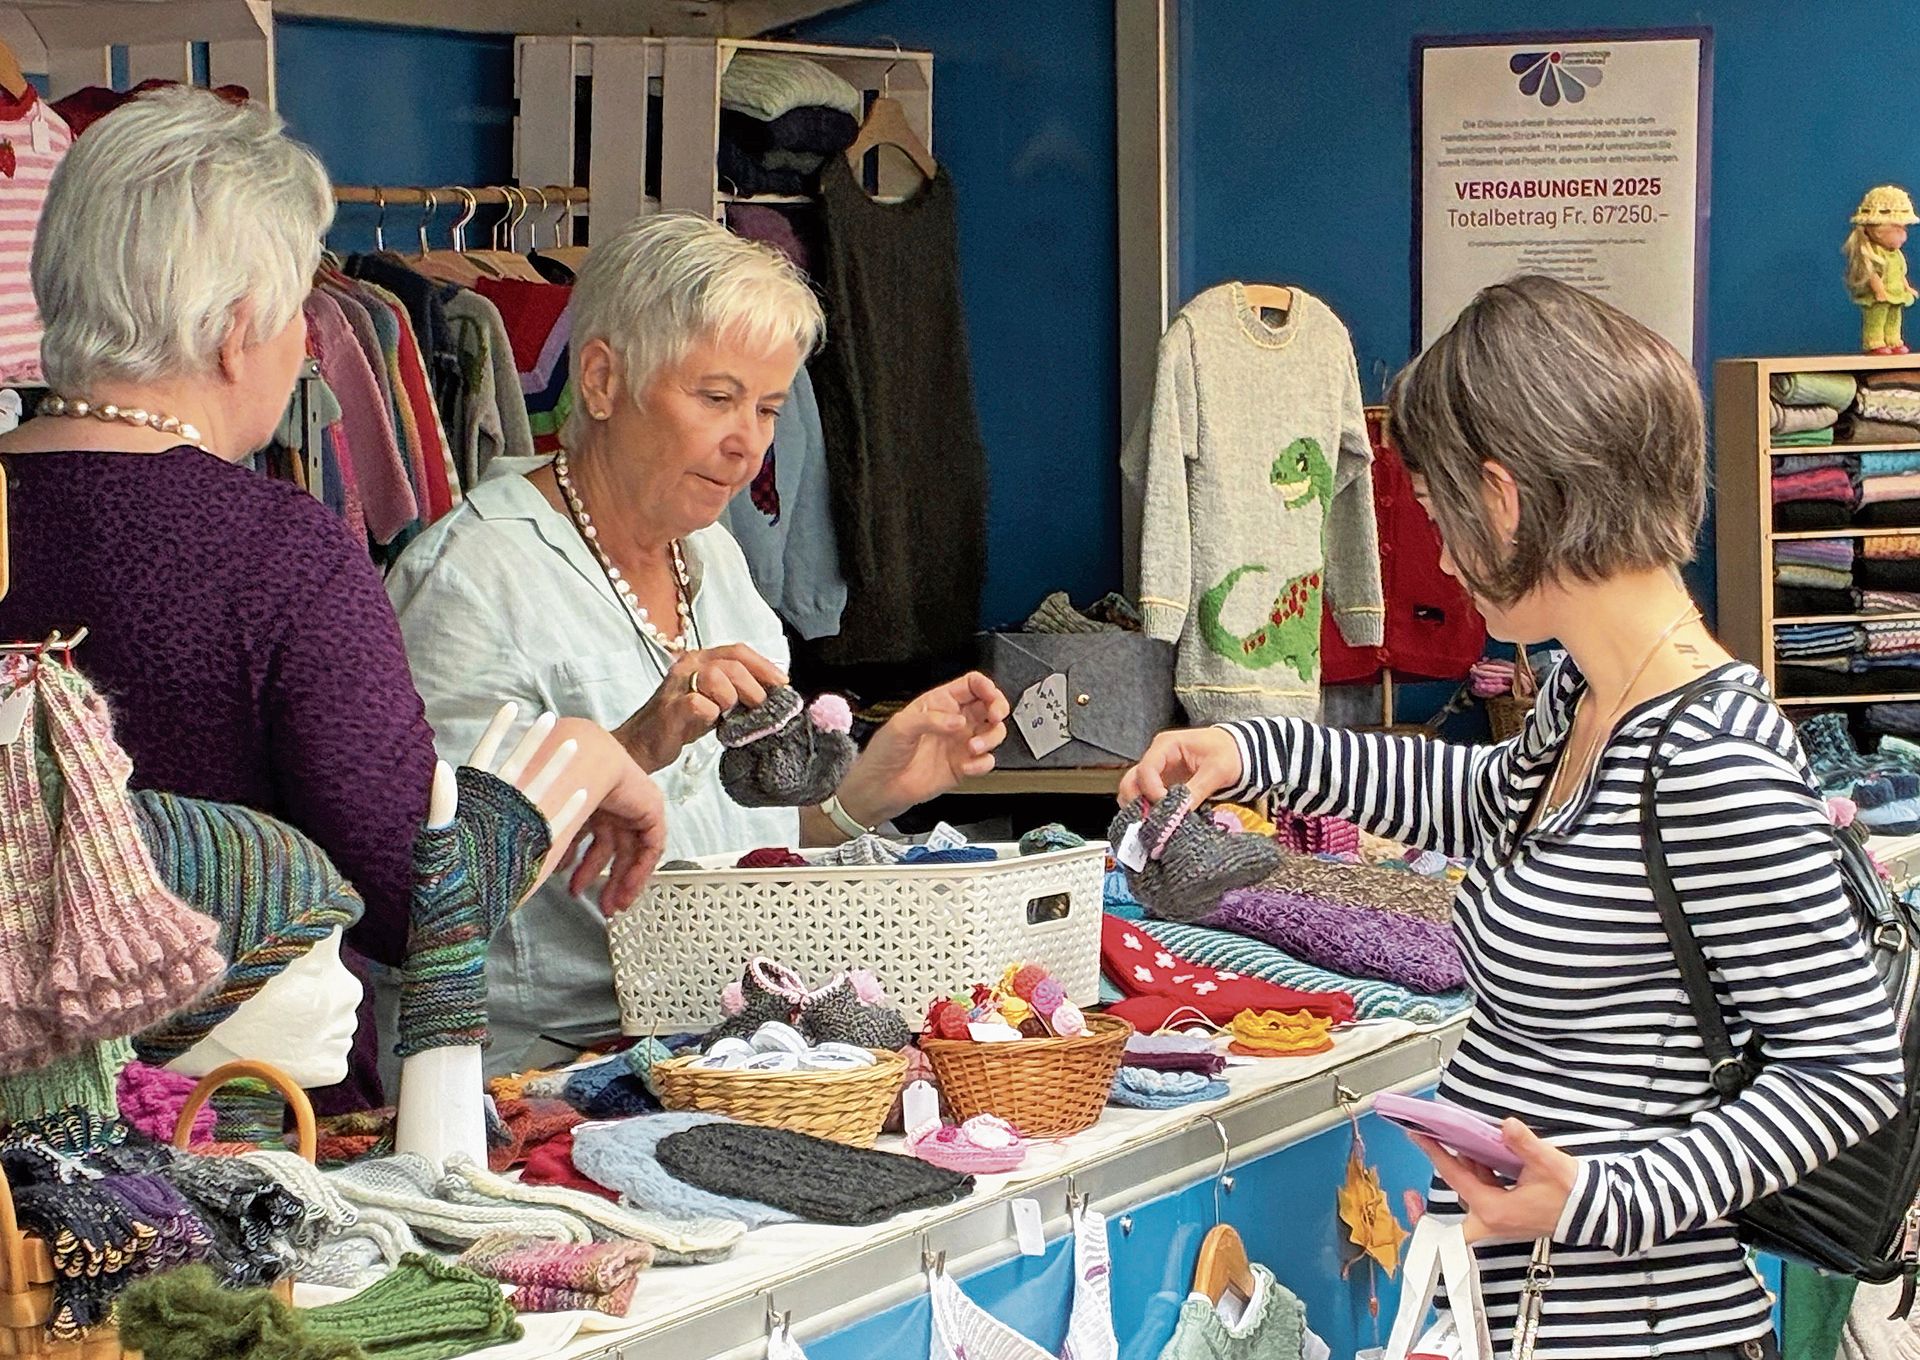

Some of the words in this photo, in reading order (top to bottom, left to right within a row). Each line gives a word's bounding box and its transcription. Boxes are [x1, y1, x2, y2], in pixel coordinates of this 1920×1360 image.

[1454, 178, 1608, 200] VERGABUNGEN
[1612, 177, 1662, 197] 2025
[1447, 207, 1558, 229] Totalbetrag
[1562, 206, 1588, 226] Fr.
